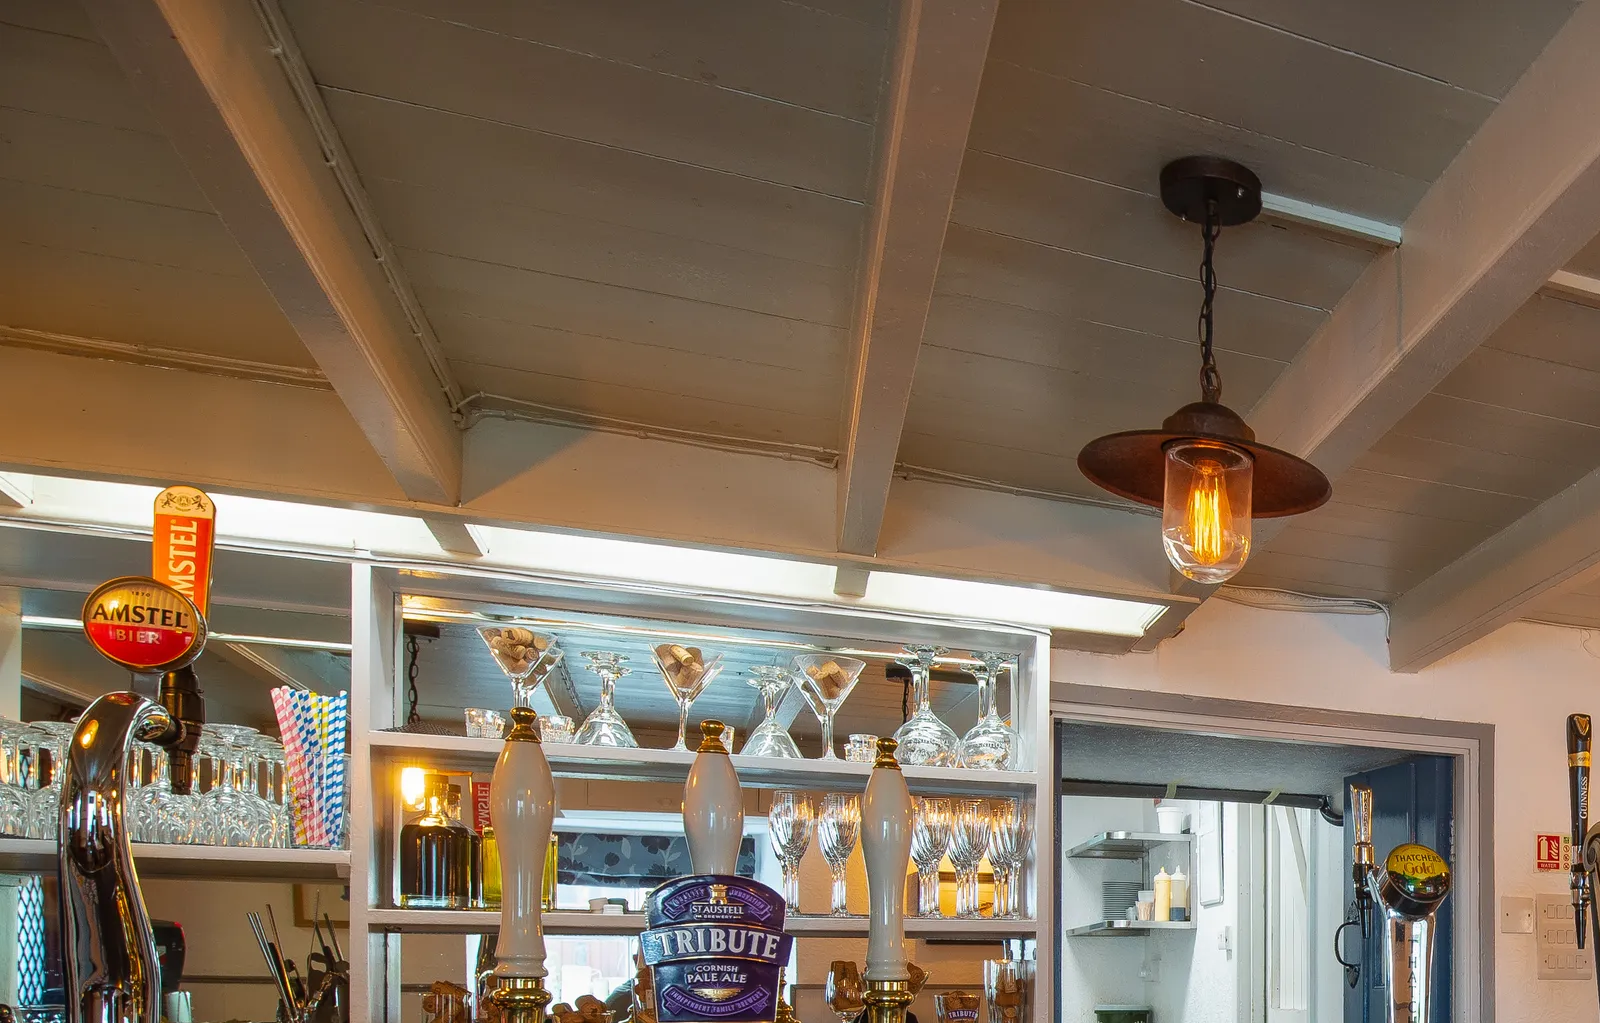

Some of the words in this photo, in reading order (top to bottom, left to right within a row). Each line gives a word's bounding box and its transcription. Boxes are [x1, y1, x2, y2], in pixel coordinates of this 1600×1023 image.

[168, 520, 198, 602] MSTEL
[92, 603, 188, 629] AMSTEL
[116, 628, 161, 645] BIER
[1579, 776, 1588, 819] GUINNESS
[1394, 854, 1442, 863] THATCHERS
[1403, 862, 1436, 876] Gold
[692, 905, 702, 914] ST
[703, 905, 744, 915] AUSTELL
[655, 928, 780, 959] TRIBUTE
[695, 964, 738, 973] CORNISH
[687, 973, 718, 984] PALE
[721, 973, 747, 984] ALE
[948, 1010, 976, 1019] TRIBUTE
